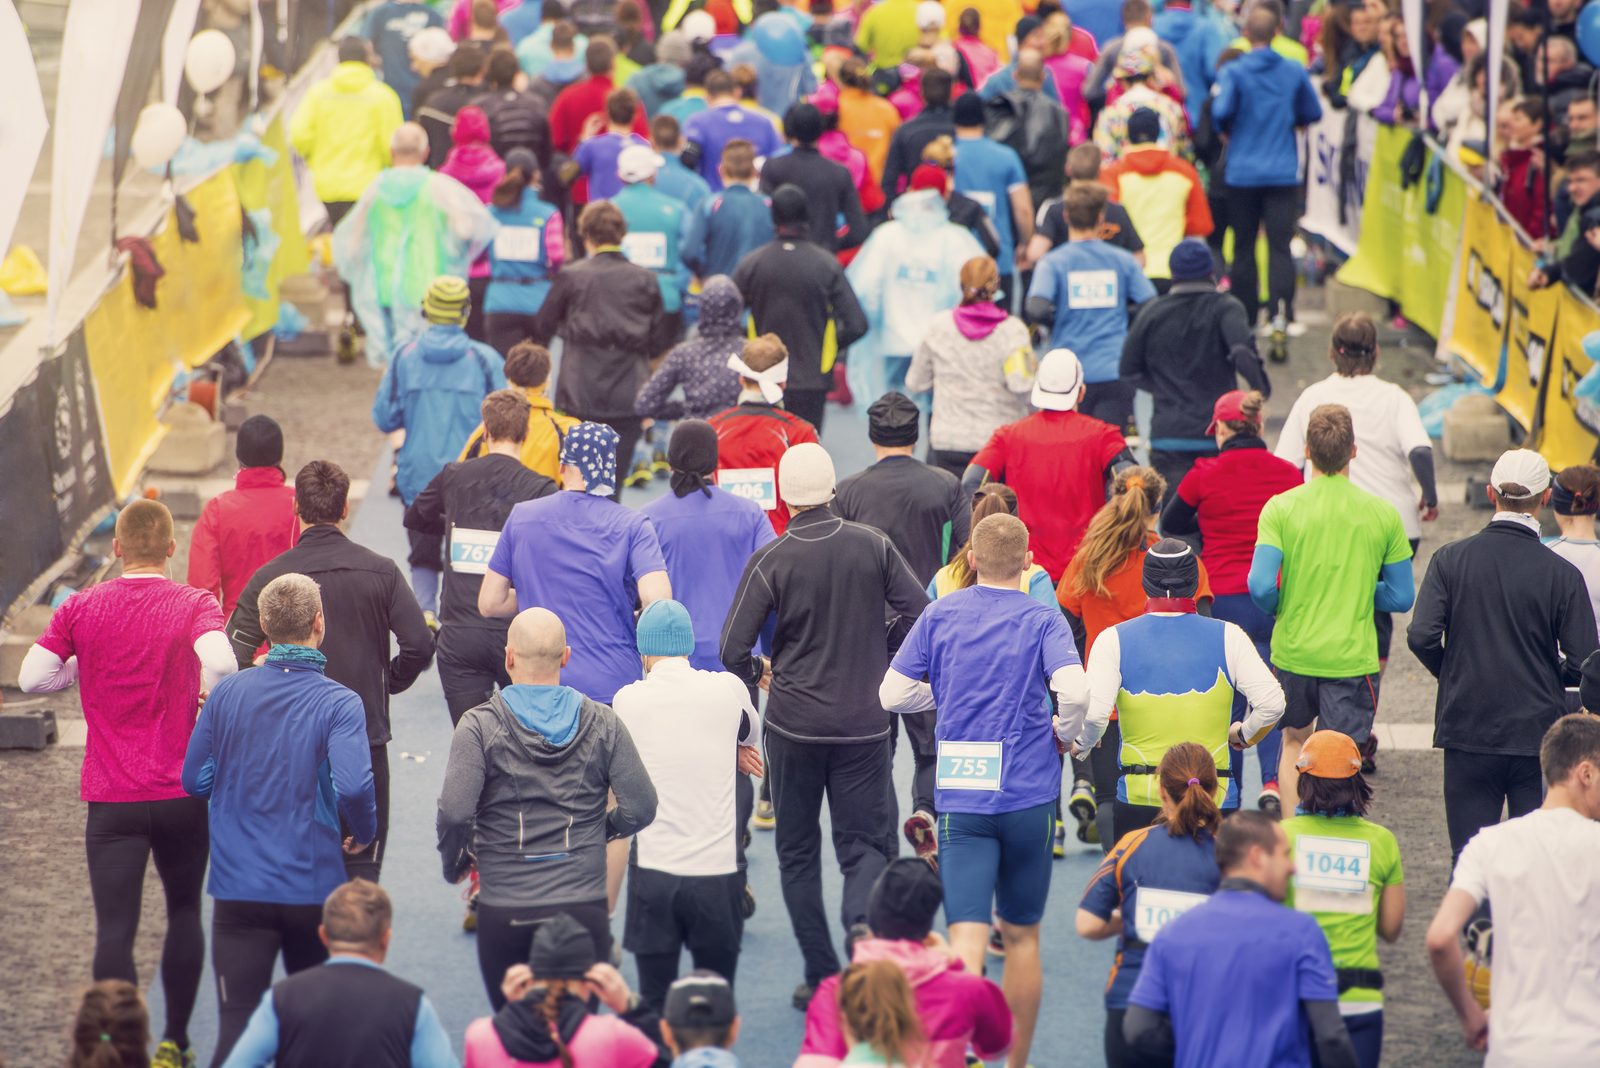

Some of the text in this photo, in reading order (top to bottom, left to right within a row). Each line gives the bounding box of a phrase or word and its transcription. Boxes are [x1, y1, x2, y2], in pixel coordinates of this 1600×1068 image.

[731, 482, 765, 500] 406
[461, 543, 495, 562] 767
[950, 758, 988, 776] 755
[1306, 851, 1361, 876] 1044
[1144, 907, 1182, 930] 10
